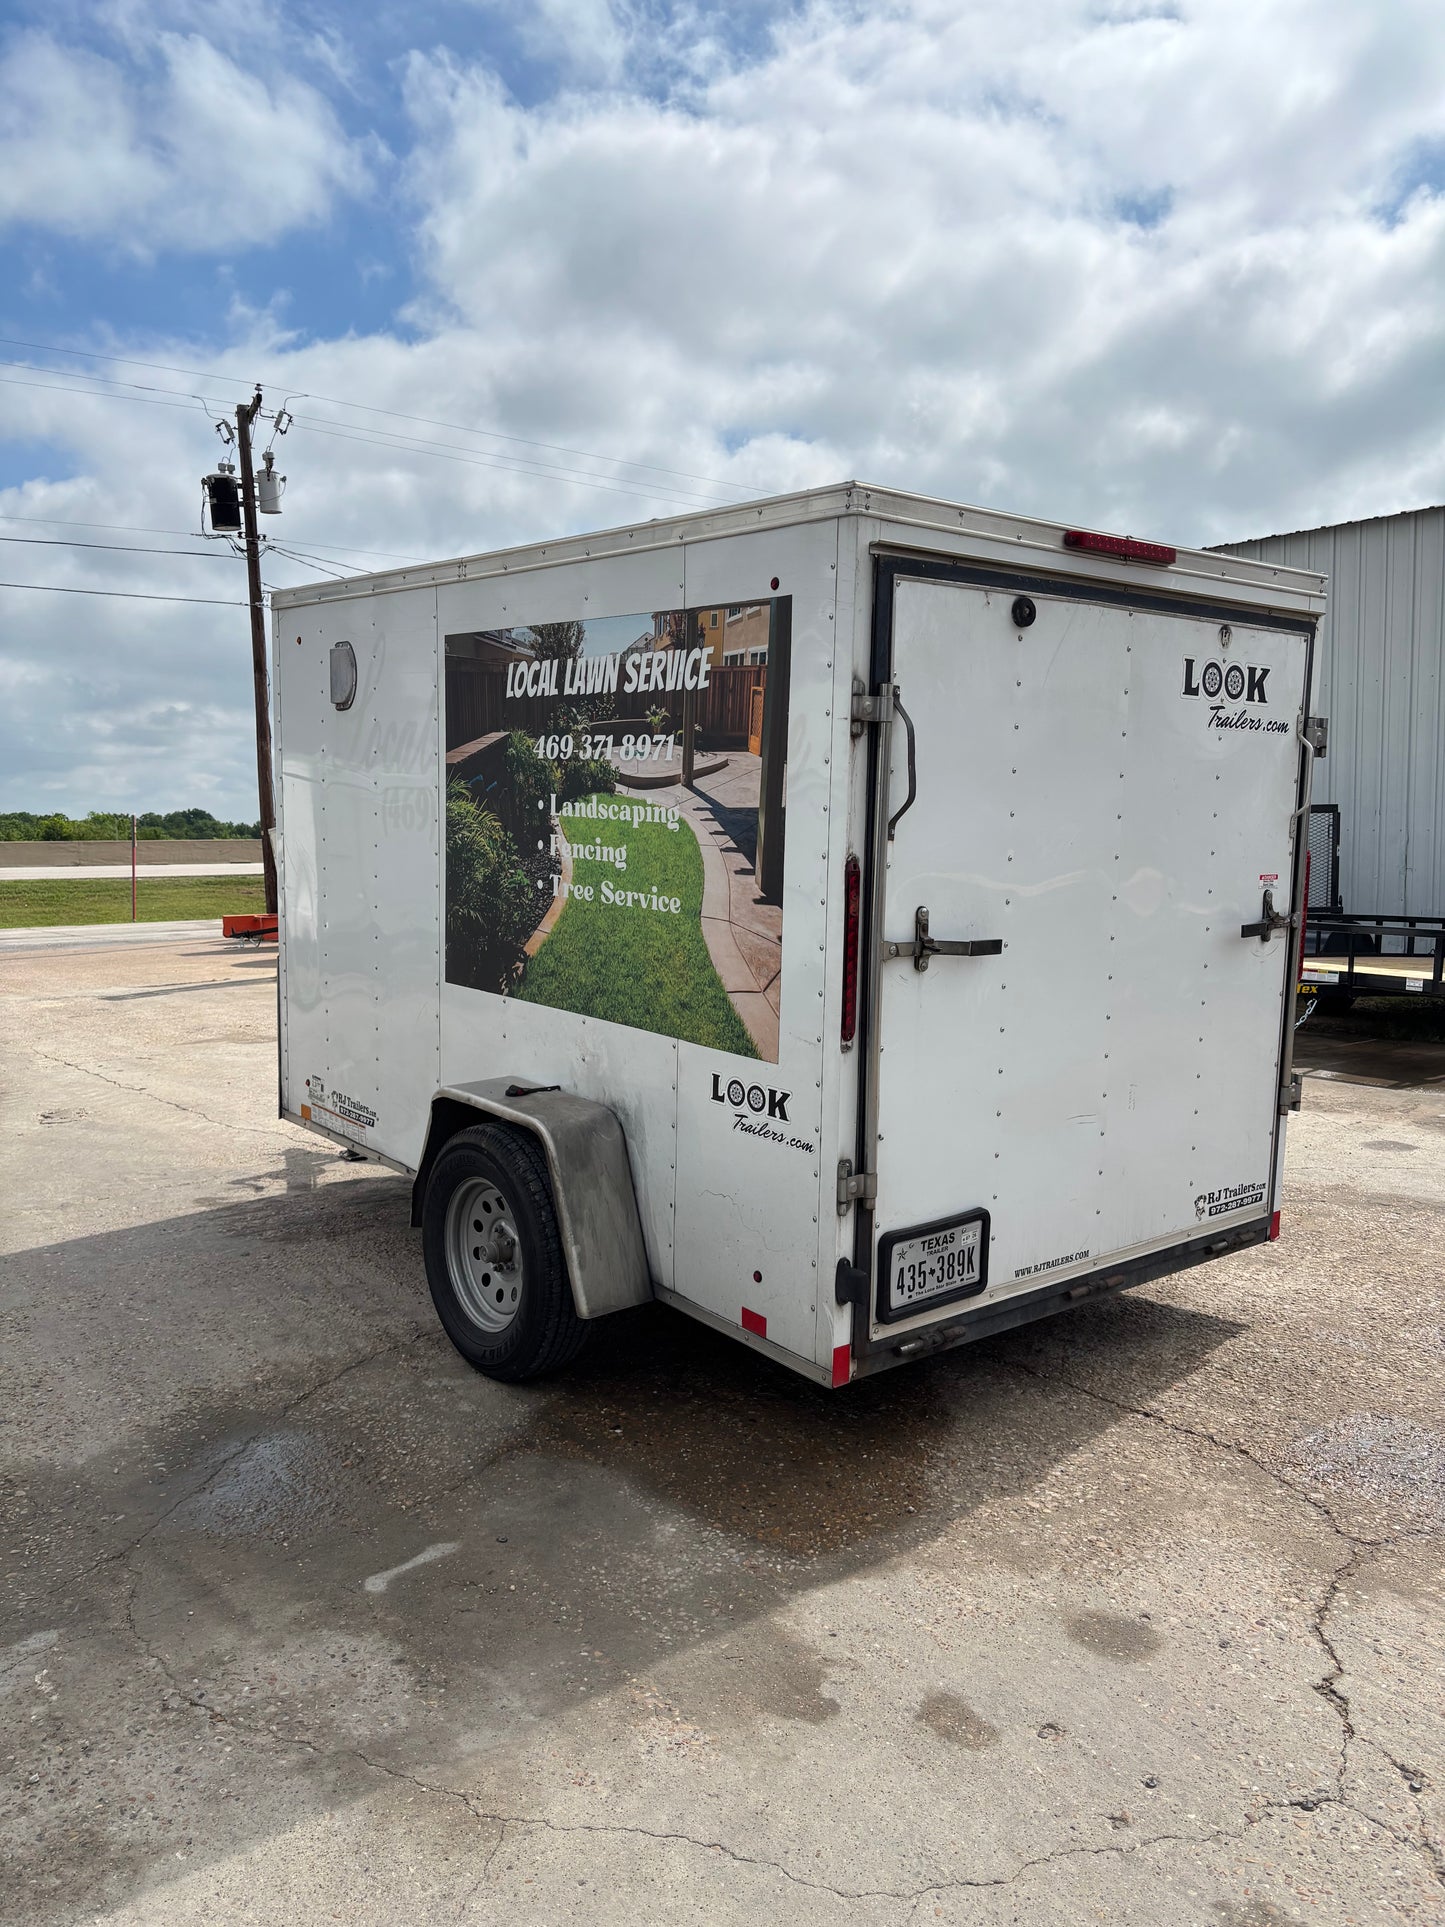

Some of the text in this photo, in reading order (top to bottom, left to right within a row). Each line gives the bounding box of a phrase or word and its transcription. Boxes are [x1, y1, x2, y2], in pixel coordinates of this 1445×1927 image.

[505, 647, 714, 699] LOCAL LAWN SERVICE
[1182, 658, 1271, 704] LOOK
[1207, 705, 1290, 734] Trailers.com
[532, 733, 676, 762] 469-371-8971
[549, 793, 681, 832] Landscaping
[549, 834, 628, 871] Fencing
[549, 874, 682, 914] Tree Service
[710, 1073, 791, 1122] LOOK
[733, 1113, 814, 1153] Trailers.com
[1206, 1189, 1222, 1205] RJ
[1209, 1193, 1262, 1215] 972-287-9977
[920, 1232, 955, 1252] TEXAS
[926, 1245, 949, 1257] TRAILER
